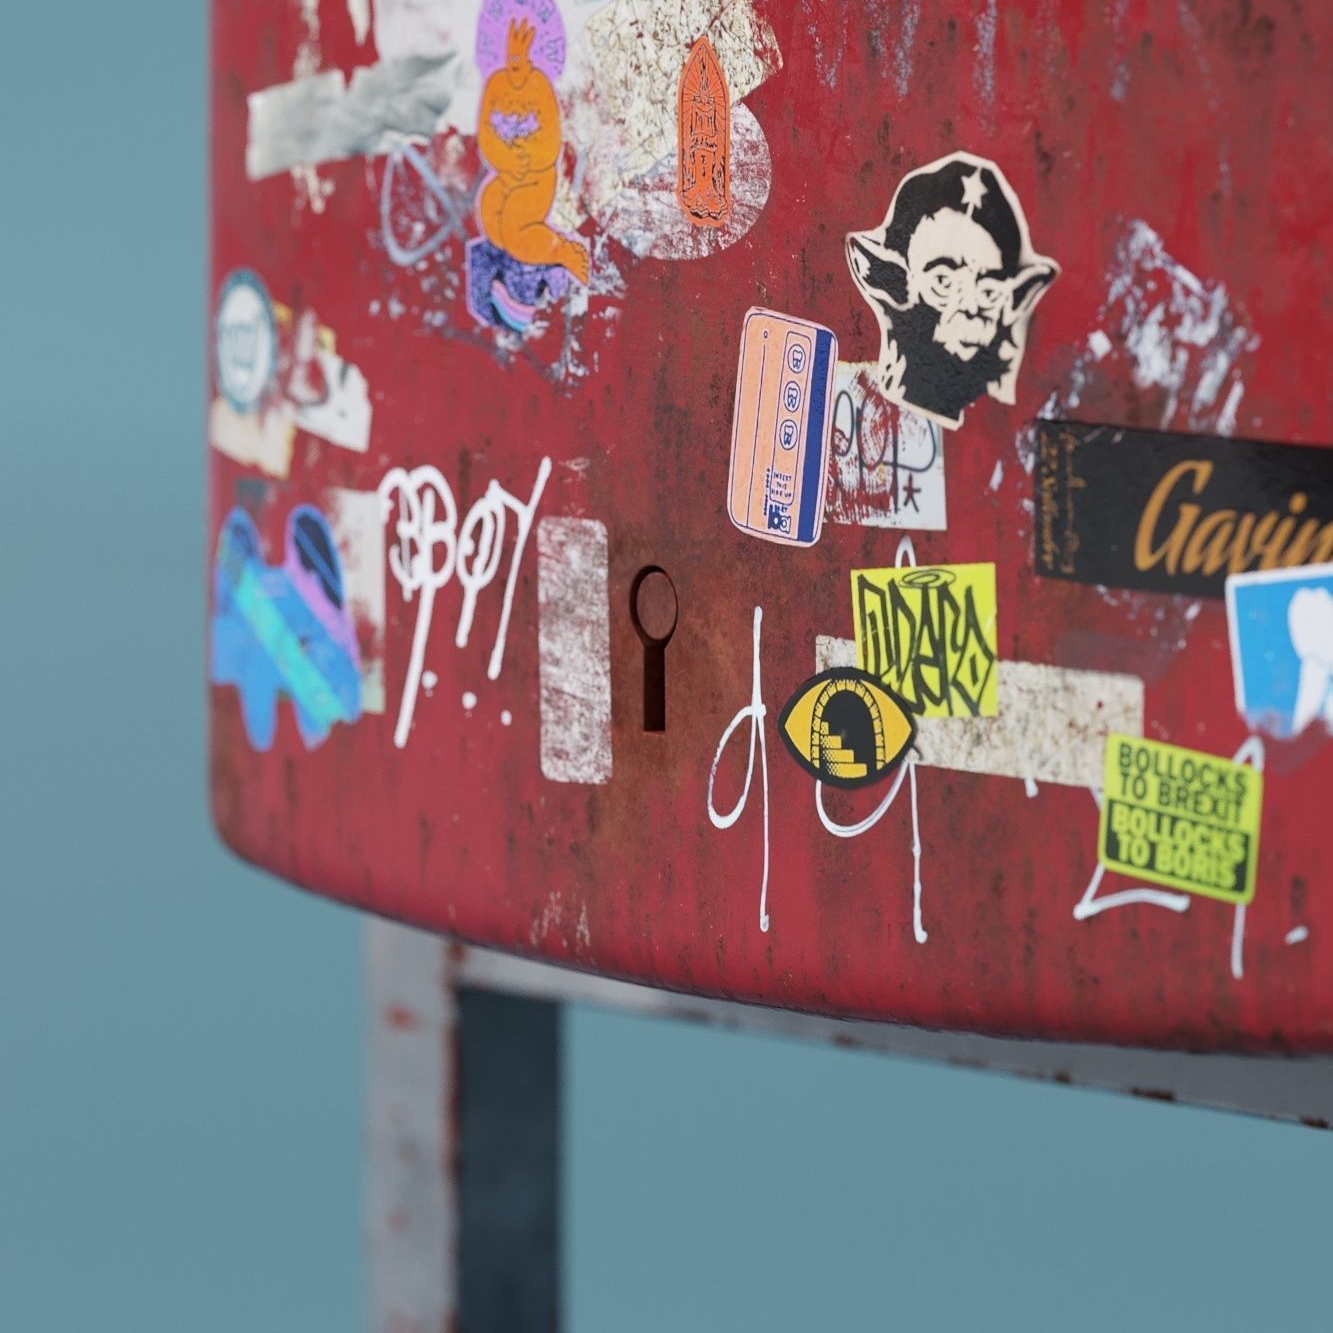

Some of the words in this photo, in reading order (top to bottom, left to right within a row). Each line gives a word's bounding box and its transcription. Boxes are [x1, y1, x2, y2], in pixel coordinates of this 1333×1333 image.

[1120, 741, 1247, 794] BOLLOCKS
[1121, 772, 1147, 801] TO
[1158, 781, 1242, 824] BREXIT
[1111, 803, 1245, 863] BOLLOCKS
[1119, 834, 1150, 867] TO
